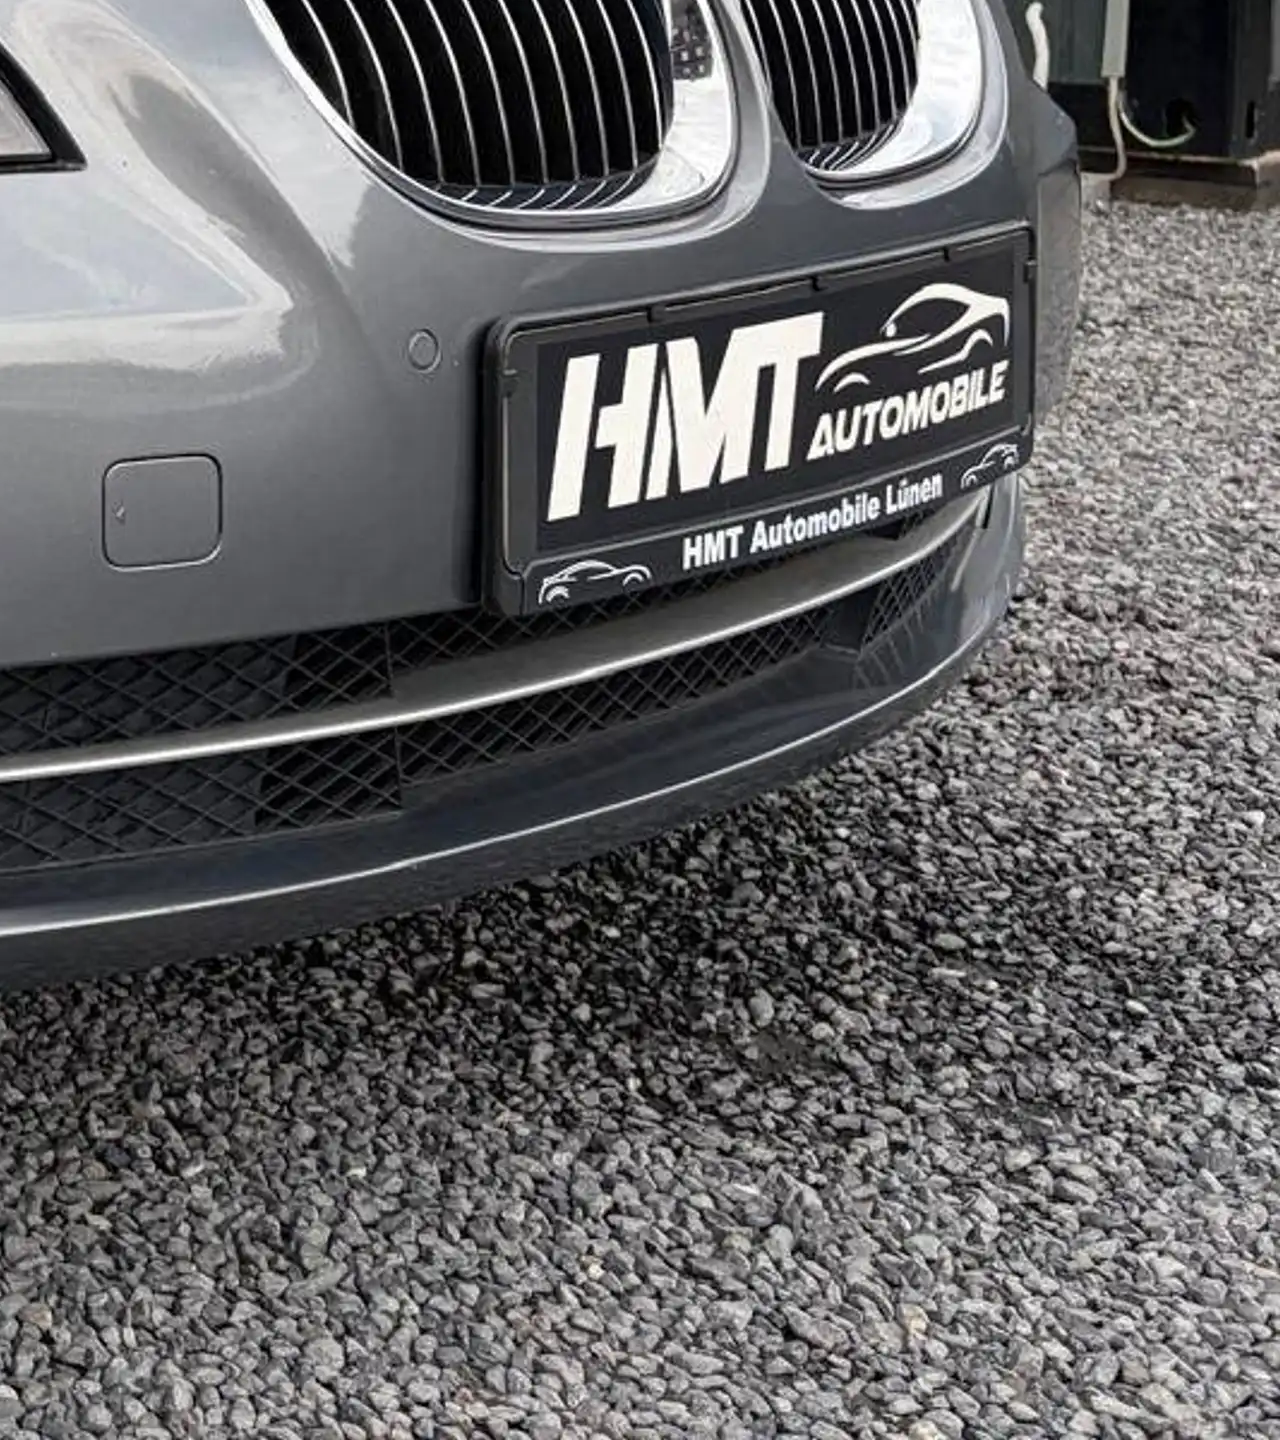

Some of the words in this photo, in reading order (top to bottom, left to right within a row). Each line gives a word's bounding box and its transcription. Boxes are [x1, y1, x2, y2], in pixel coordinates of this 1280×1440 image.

[548, 312, 824, 522] HMT
[806, 360, 1008, 460] AUTOMOBILE
[682, 526, 744, 570] HMT
[749, 492, 881, 554] Automobile
[885, 473, 942, 515] Lünen
